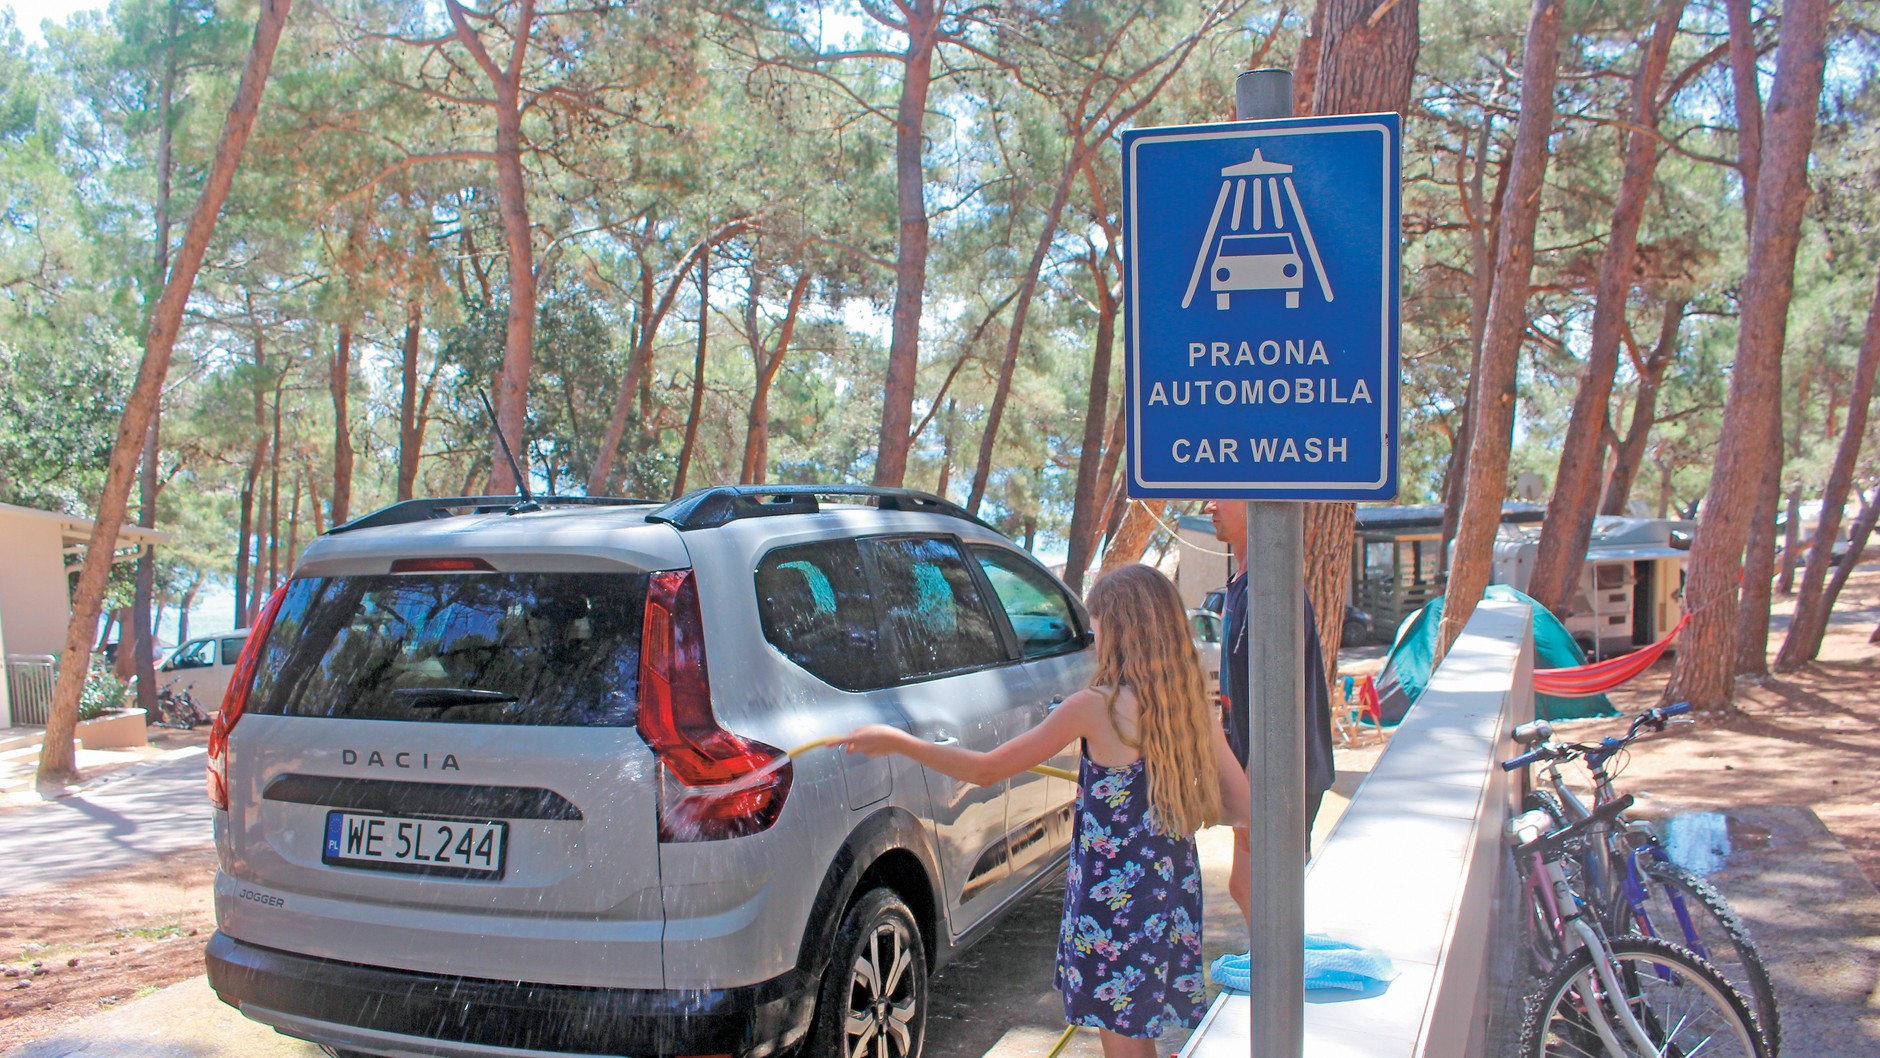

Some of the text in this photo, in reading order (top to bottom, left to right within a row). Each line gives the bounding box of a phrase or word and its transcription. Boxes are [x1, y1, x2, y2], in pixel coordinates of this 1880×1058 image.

[1188, 340, 1330, 367] PRAONA
[1147, 377, 1373, 406] AUTOMOBILA
[1171, 437, 1348, 463] CAR WASH
[342, 749, 460, 771] DACIA
[328, 840, 339, 850] PL
[347, 818, 494, 866] WE 5L244
[239, 889, 285, 908] JOGGER
